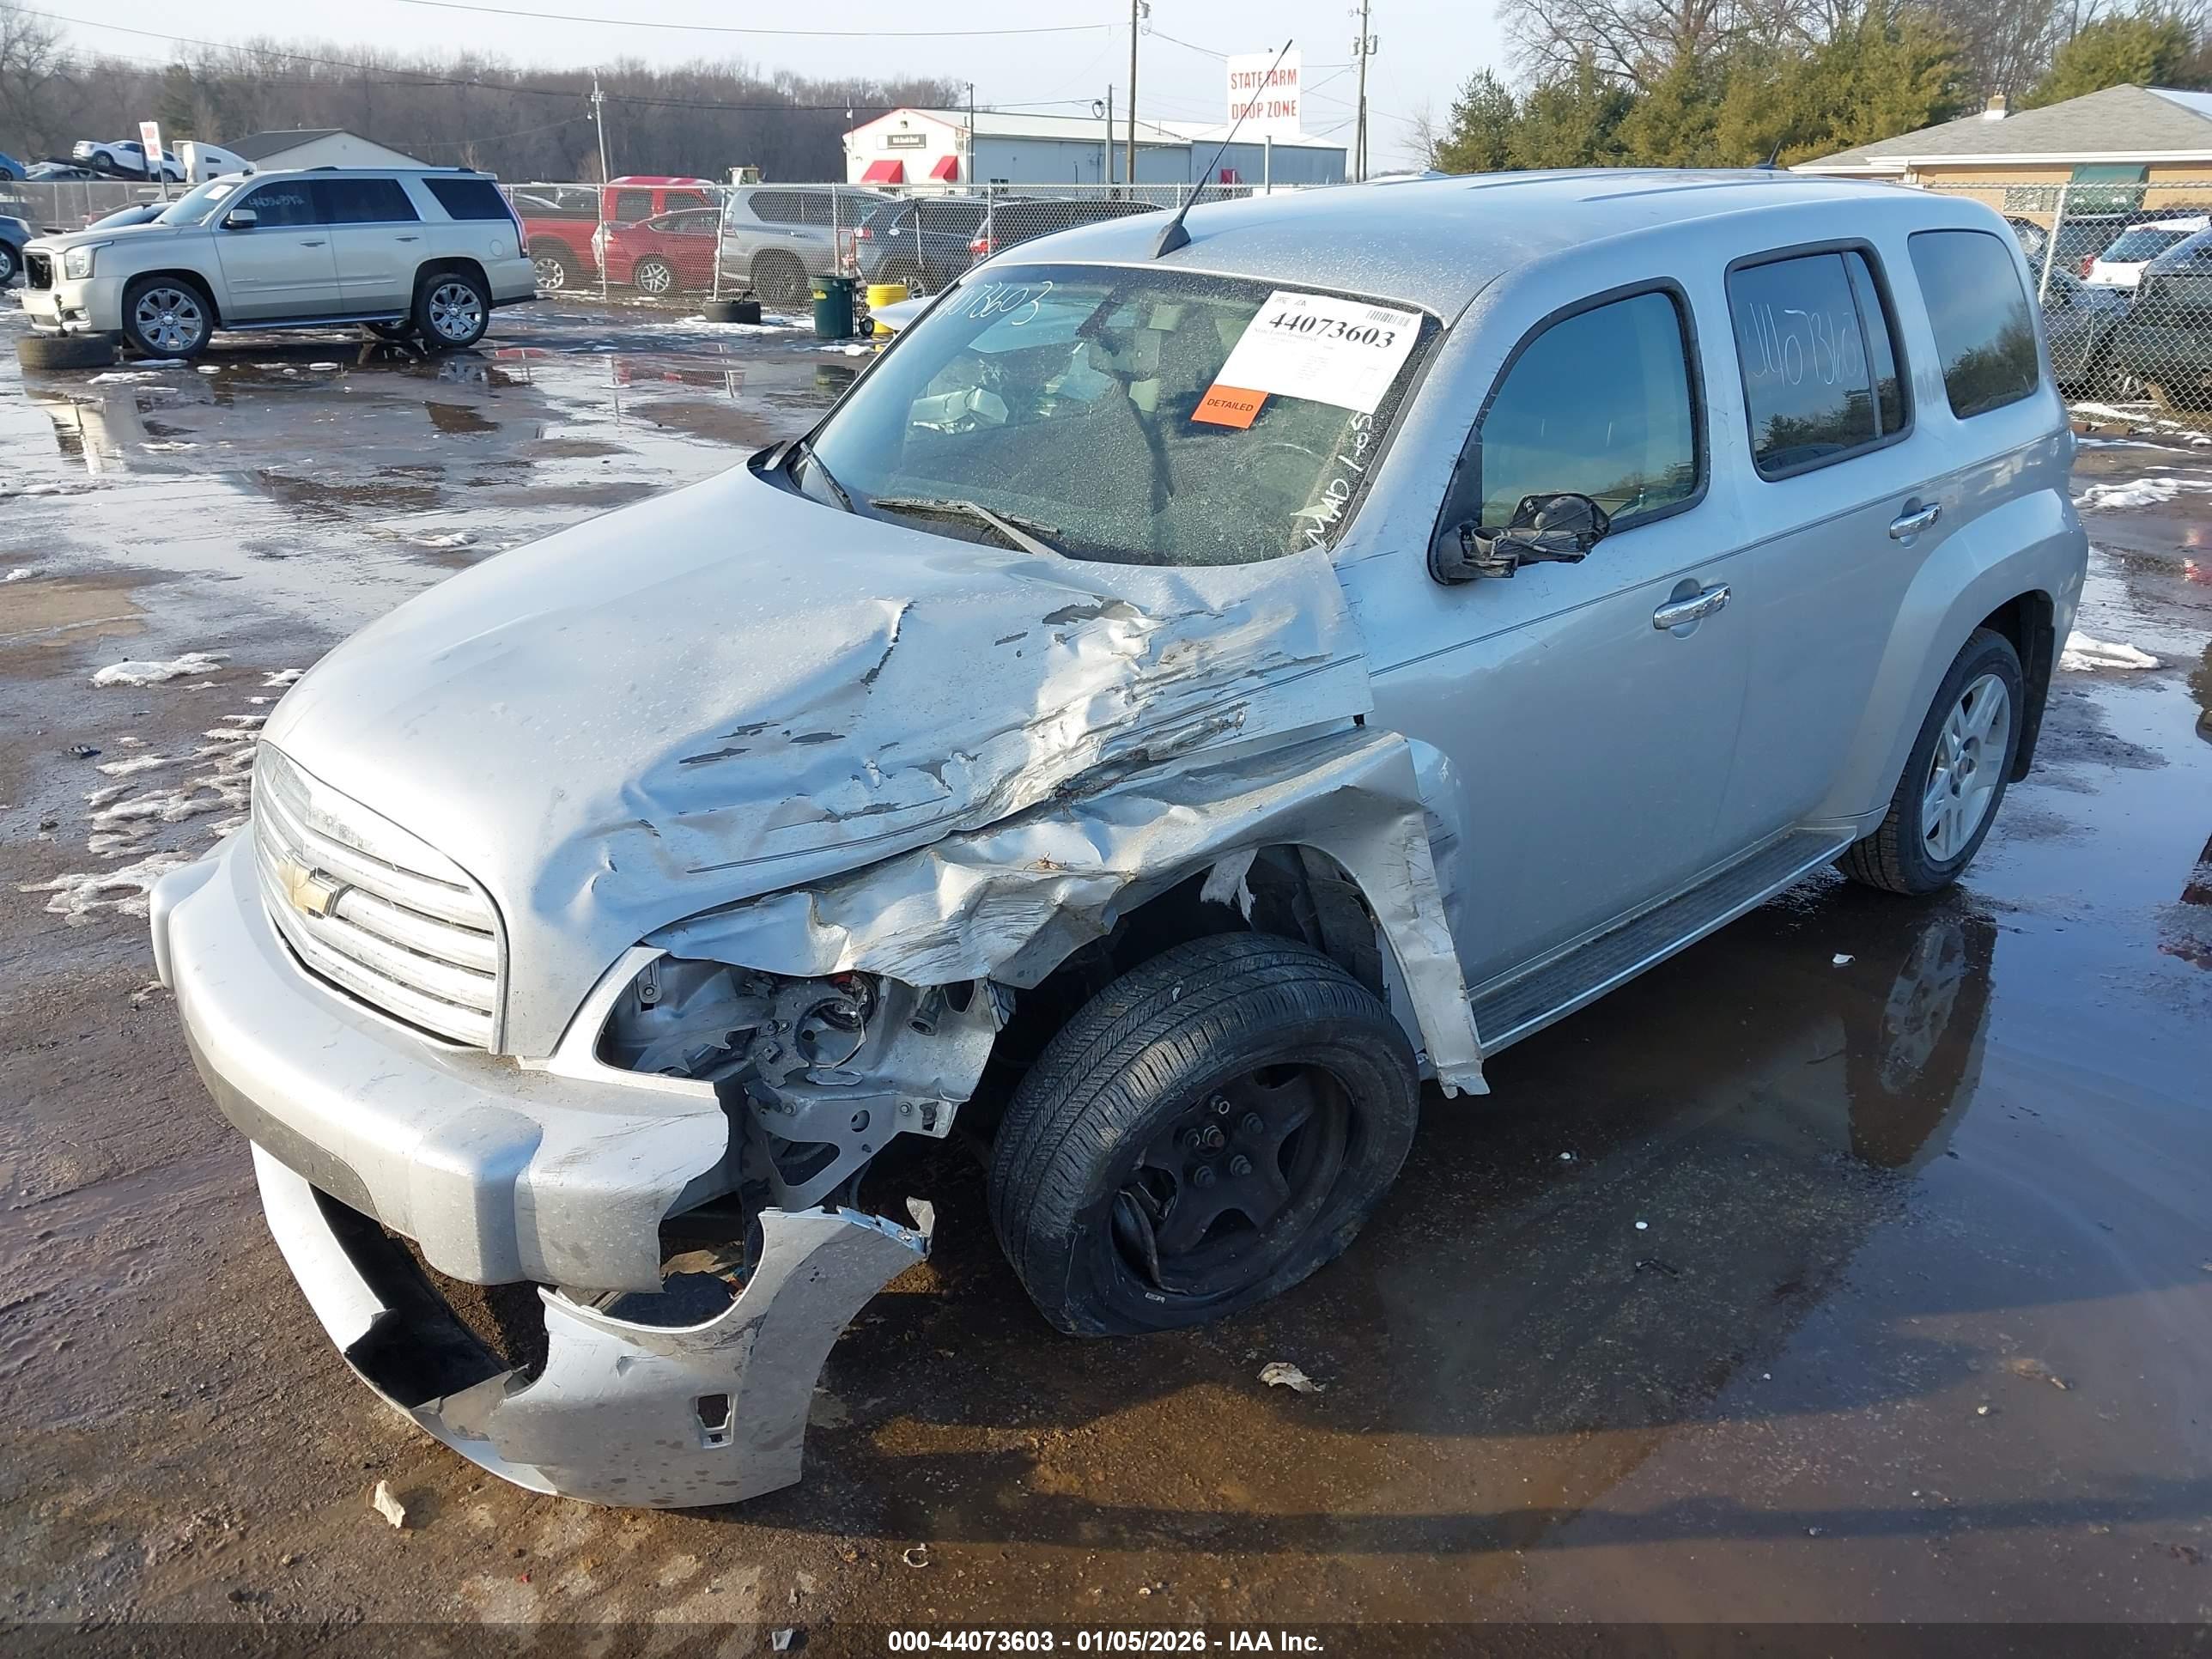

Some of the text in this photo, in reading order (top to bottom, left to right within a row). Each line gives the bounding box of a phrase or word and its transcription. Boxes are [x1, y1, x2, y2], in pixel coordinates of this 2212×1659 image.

[1231, 69, 1297, 90] STATE FARM
[1231, 100, 1297, 120] DROP ZONE
[1269, 312, 1396, 349] 44073603
[1206, 398, 1255, 412] DETAILED
